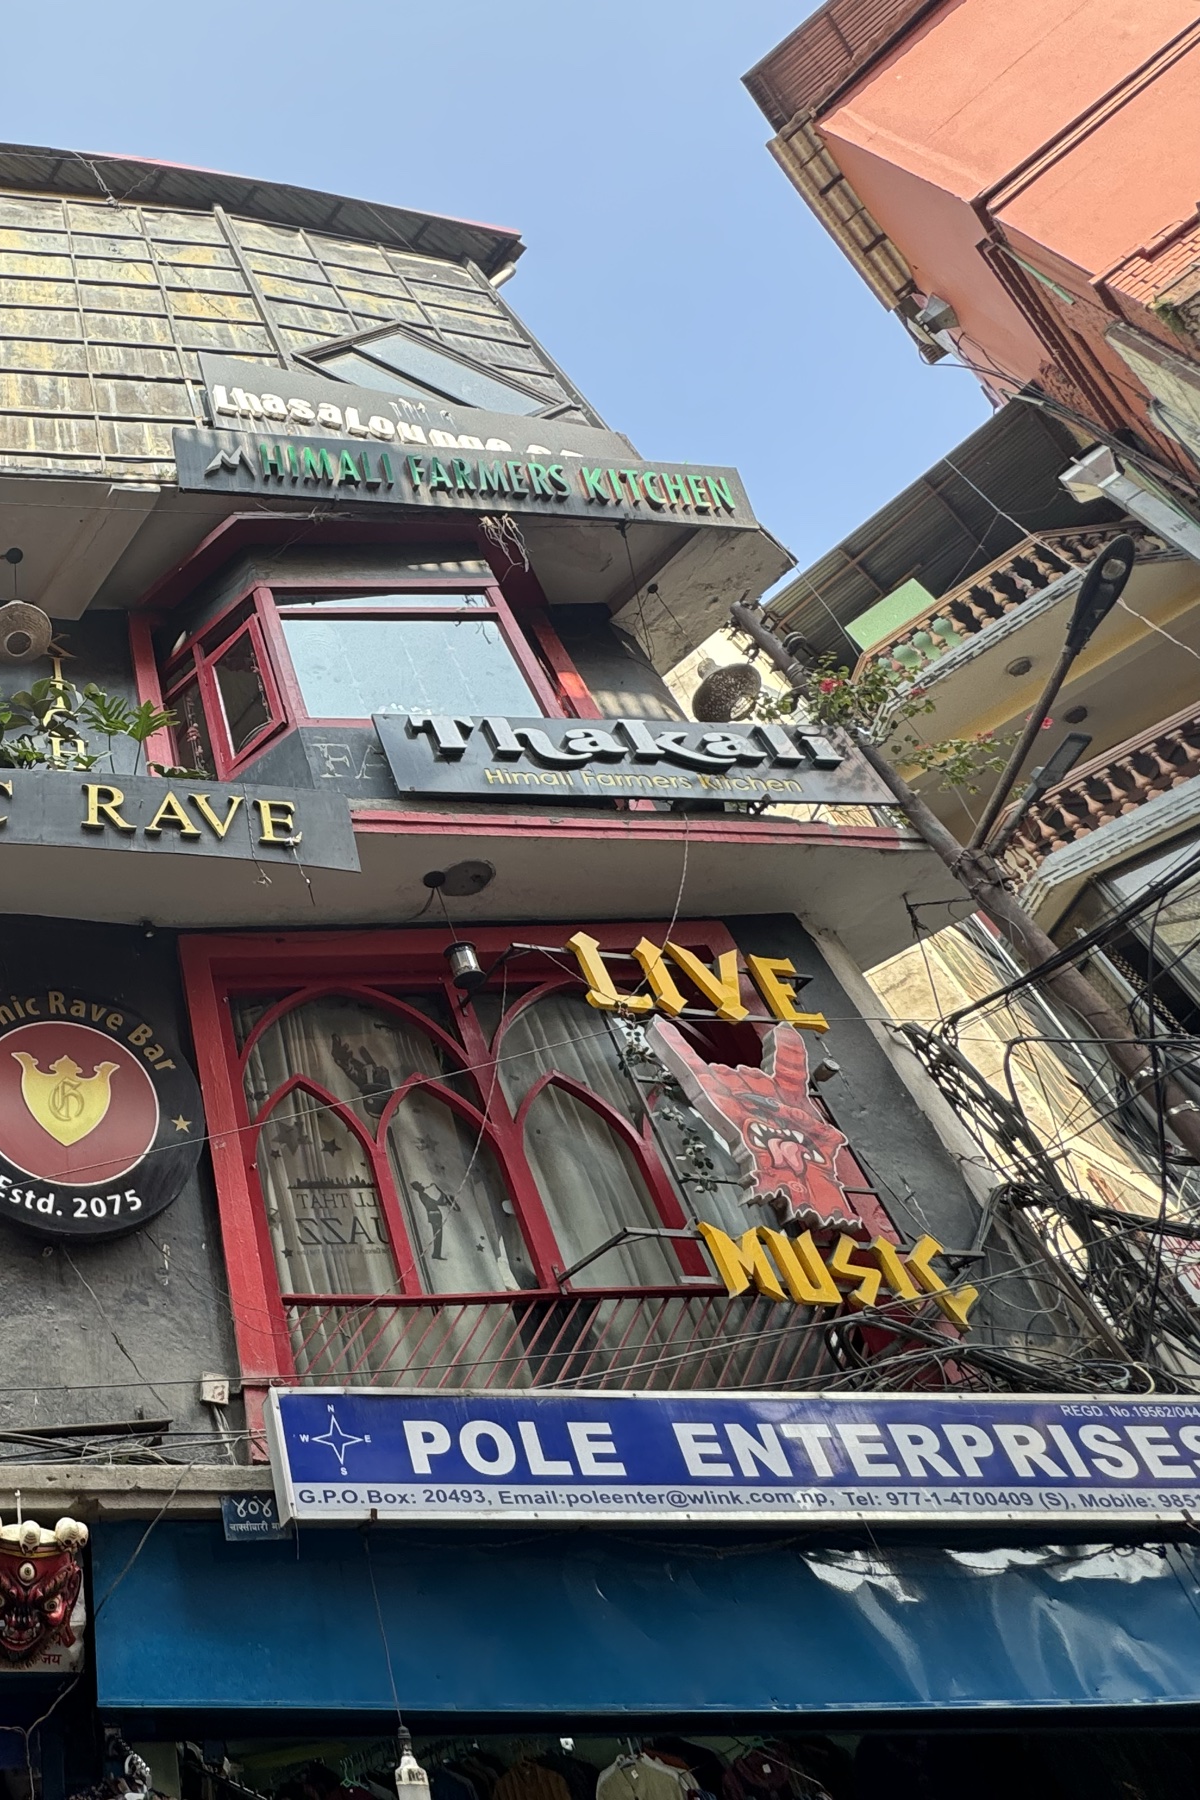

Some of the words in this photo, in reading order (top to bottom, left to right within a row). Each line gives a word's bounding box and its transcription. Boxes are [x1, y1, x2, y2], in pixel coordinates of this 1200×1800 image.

[258, 444, 394, 489] HIMALI
[406, 453, 570, 501] FARMERS
[581, 466, 736, 512] KITCHEN
[405, 713, 846, 770] Thakali
[484, 767, 574, 787] Himali
[582, 769, 692, 790] Farmers
[697, 773, 804, 794] Kitchen
[81, 783, 302, 846] RAVE
[566, 931, 831, 1034] LIVE
[48, 990, 124, 1031] Rave
[127, 1022, 177, 1073] Bar
[72, 1189, 143, 1218] 2075
[699, 1221, 979, 1334] MUSIC
[1060, 1404, 1108, 1417] REGD.
[403, 1420, 627, 1477] POLE
[423, 1489, 492, 1506] 20493,
[842, 1491, 882, 1506] Tel:
[886, 1491, 1033, 1506] 977-1-4700409
[1039, 1492, 1076, 1510] (S),
[1078, 1493, 1155, 1508] Mobile:
